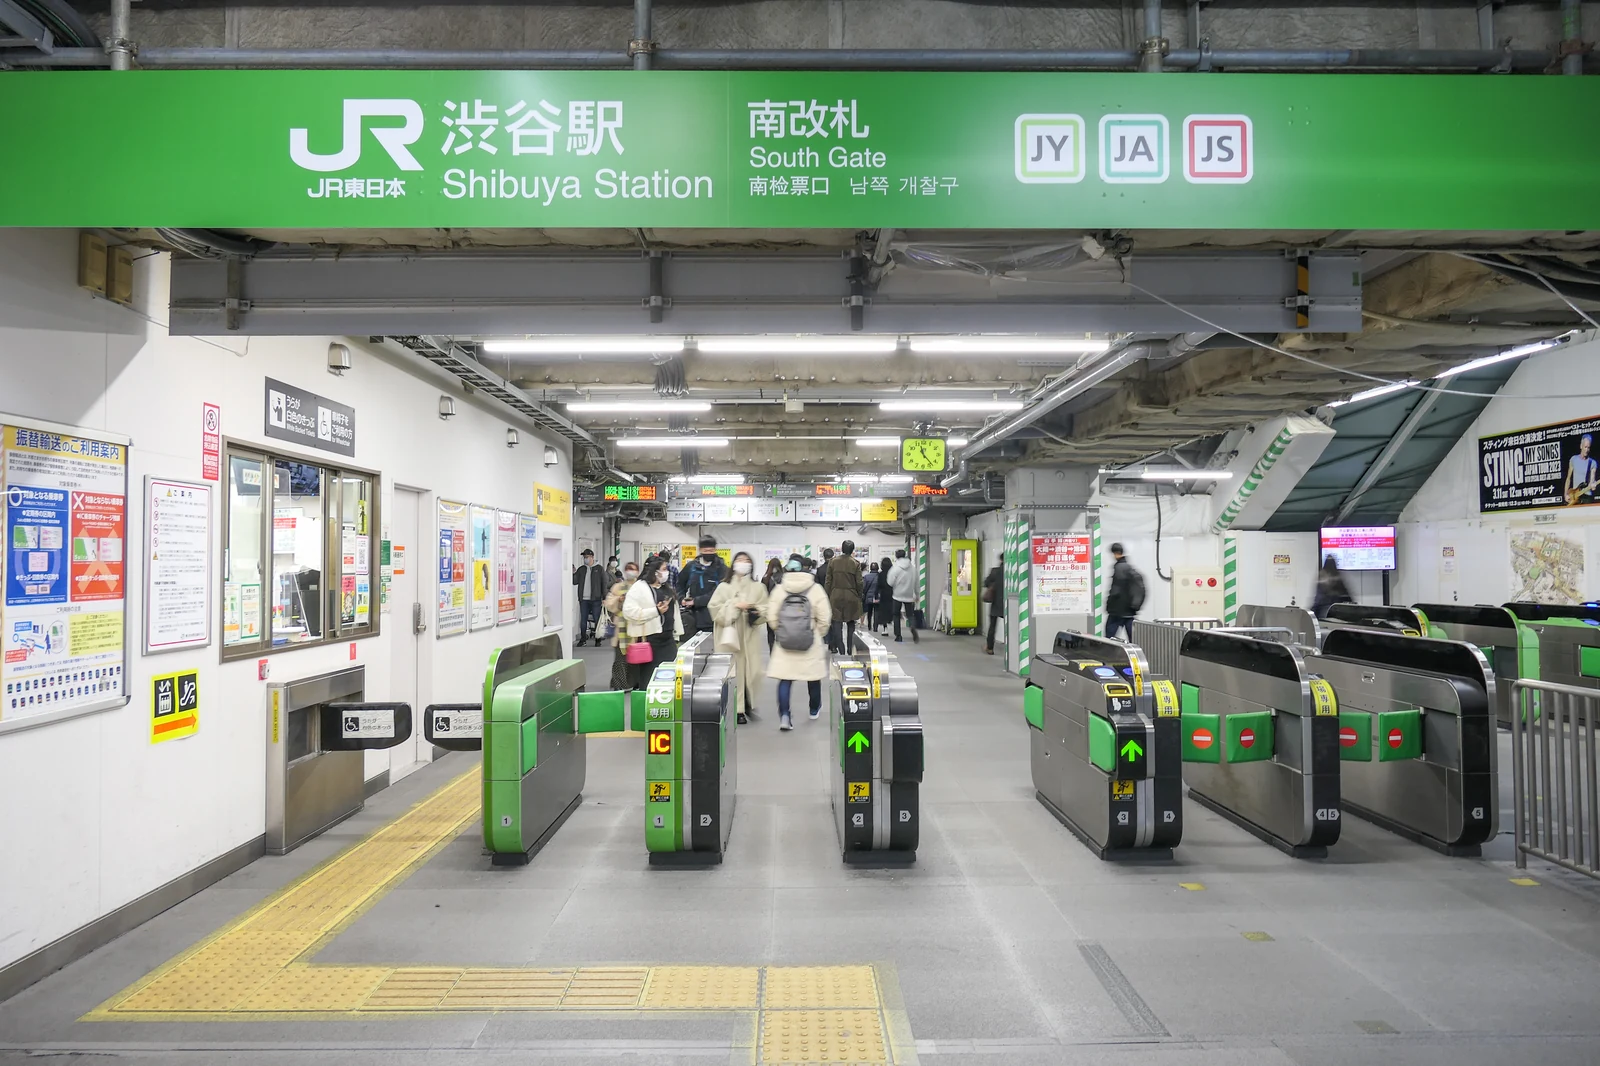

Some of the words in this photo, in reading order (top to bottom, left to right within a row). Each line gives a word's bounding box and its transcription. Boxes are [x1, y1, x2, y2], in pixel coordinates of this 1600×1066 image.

[440, 99, 625, 156] 渋谷駅
[748, 99, 870, 139] 南改札
[290, 98, 424, 172] JR
[1030, 135, 1069, 162] JY
[1113, 135, 1155, 162] JA
[1200, 135, 1235, 162] JS
[749, 146, 820, 168] South
[828, 146, 887, 168] Gate
[308, 178, 406, 198] JR東日本
[443, 168, 582, 206] Shibuya
[594, 168, 713, 199] Station
[748, 176, 830, 196] 南检票口
[849, 176, 890, 196] 남쪽
[899, 176, 960, 196] 개찰구
[286, 410, 315, 428] 白色のきっぷ
[16, 428, 119, 460] 振替輸送のご利用案内
[1526, 448, 1536, 464] MY
[1537, 444, 1559, 461] SONGS
[1483, 448, 1524, 488] STING
[650, 708, 670, 719] 専用
[650, 733, 670, 752] IC
